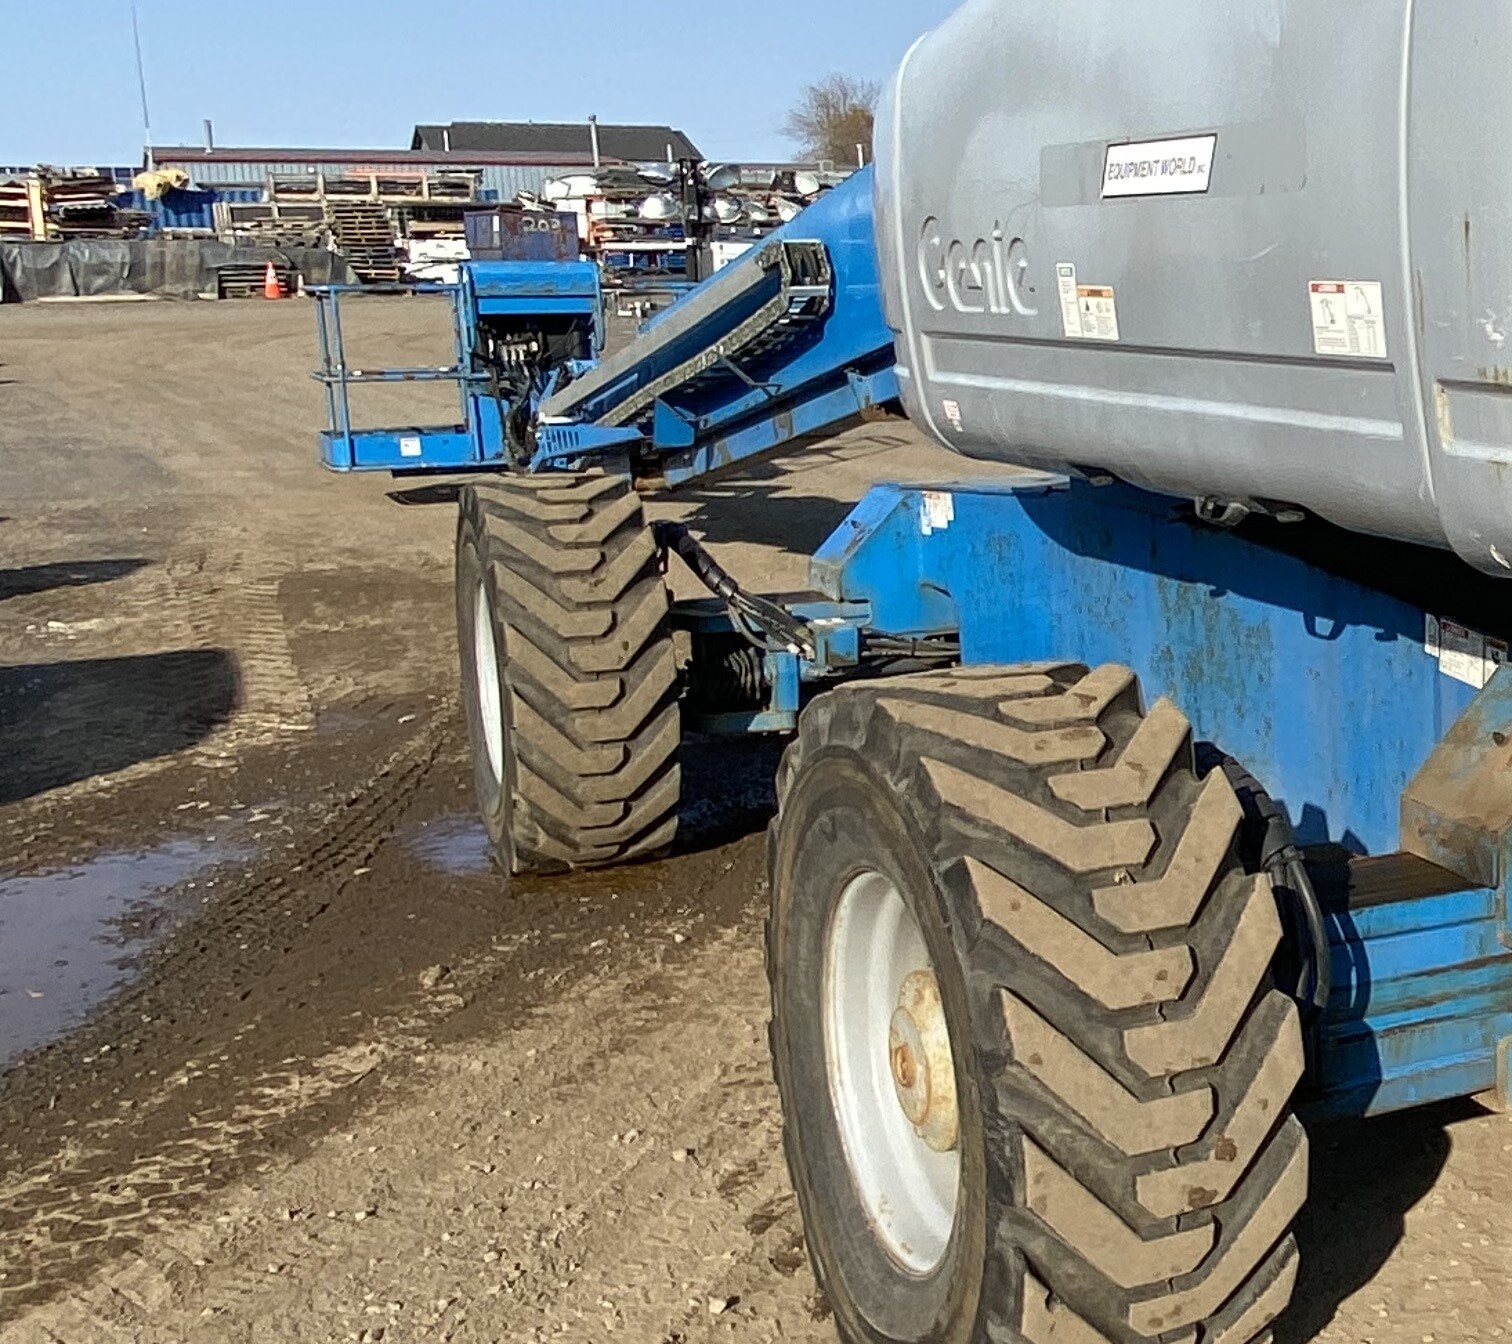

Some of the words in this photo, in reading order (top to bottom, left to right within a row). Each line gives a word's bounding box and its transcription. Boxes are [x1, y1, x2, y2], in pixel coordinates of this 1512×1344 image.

[1108, 160, 1160, 181] EQUIPMENT
[1160, 156, 1196, 176] WORLD
[917, 215, 1038, 316] Genie
